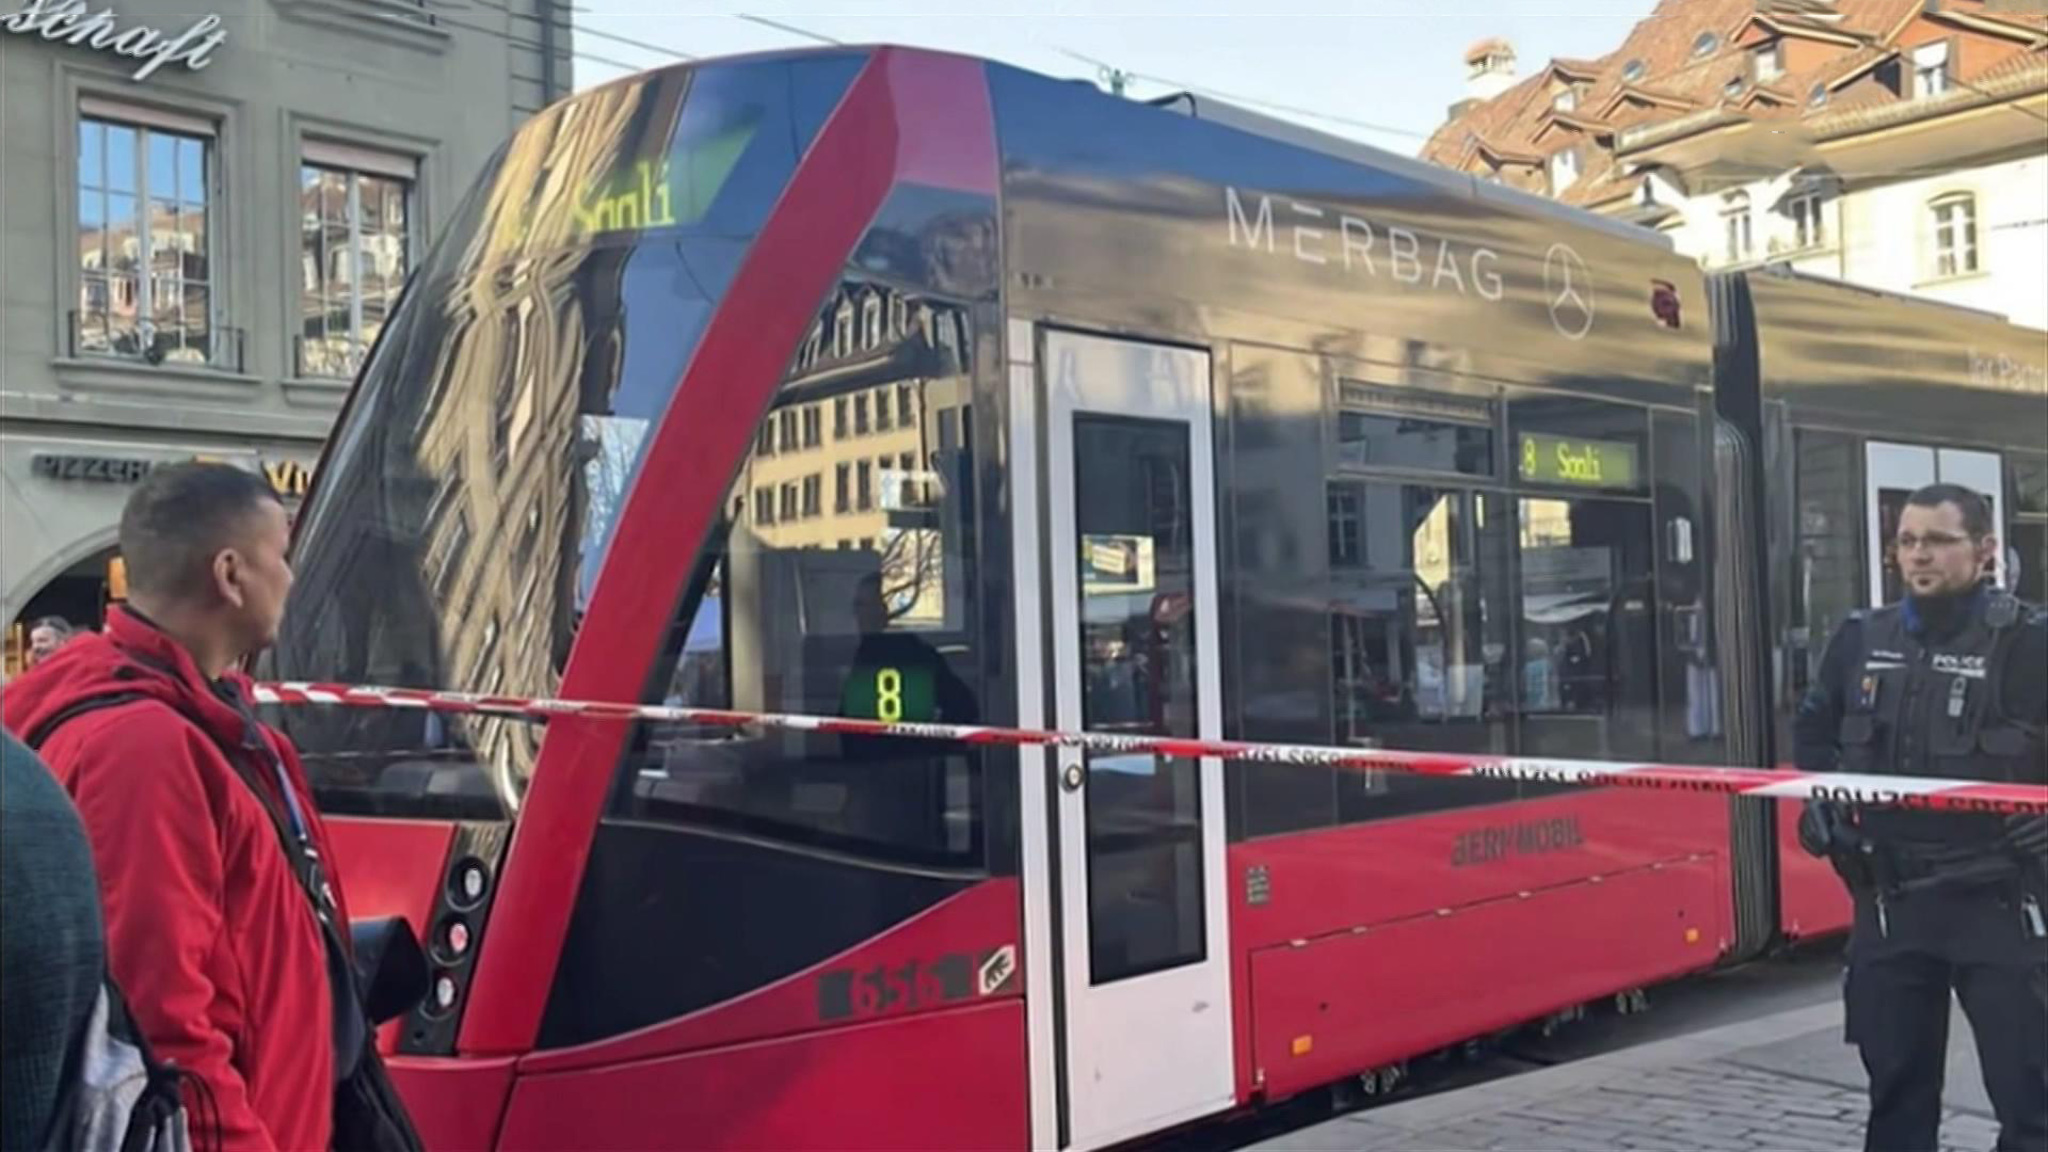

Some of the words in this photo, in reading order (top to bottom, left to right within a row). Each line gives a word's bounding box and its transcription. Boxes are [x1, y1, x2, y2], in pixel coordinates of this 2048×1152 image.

[1226, 186, 1504, 300] MERBAG
[31, 454, 152, 483] PIZZER
[1524, 437, 1537, 477] 8
[1931, 653, 1986, 670] POLICE
[876, 667, 902, 723] 8
